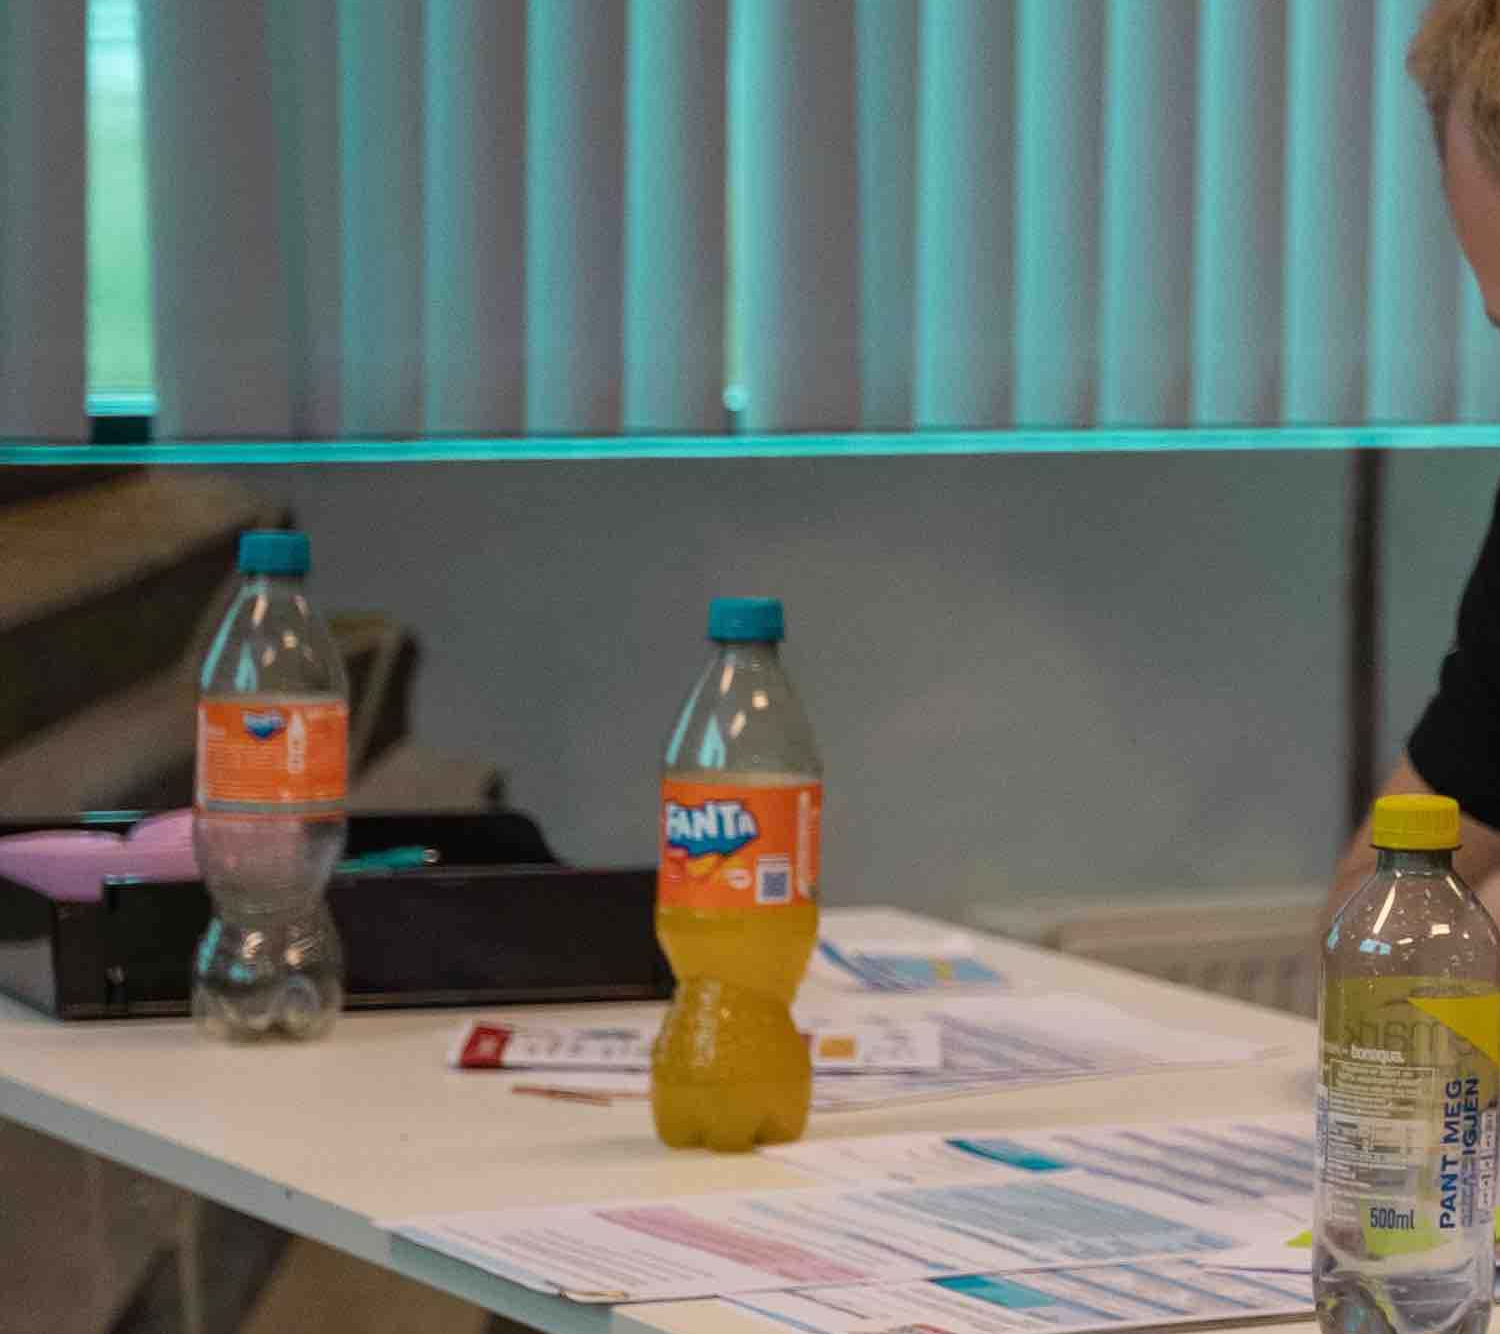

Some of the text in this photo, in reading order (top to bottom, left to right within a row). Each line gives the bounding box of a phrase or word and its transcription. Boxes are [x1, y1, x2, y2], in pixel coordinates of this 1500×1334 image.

[1440, 1078, 1463, 1229] PANT MEG
[1462, 1076, 1480, 1156] IGJEN
[1369, 1206, 1415, 1230] 500ml
